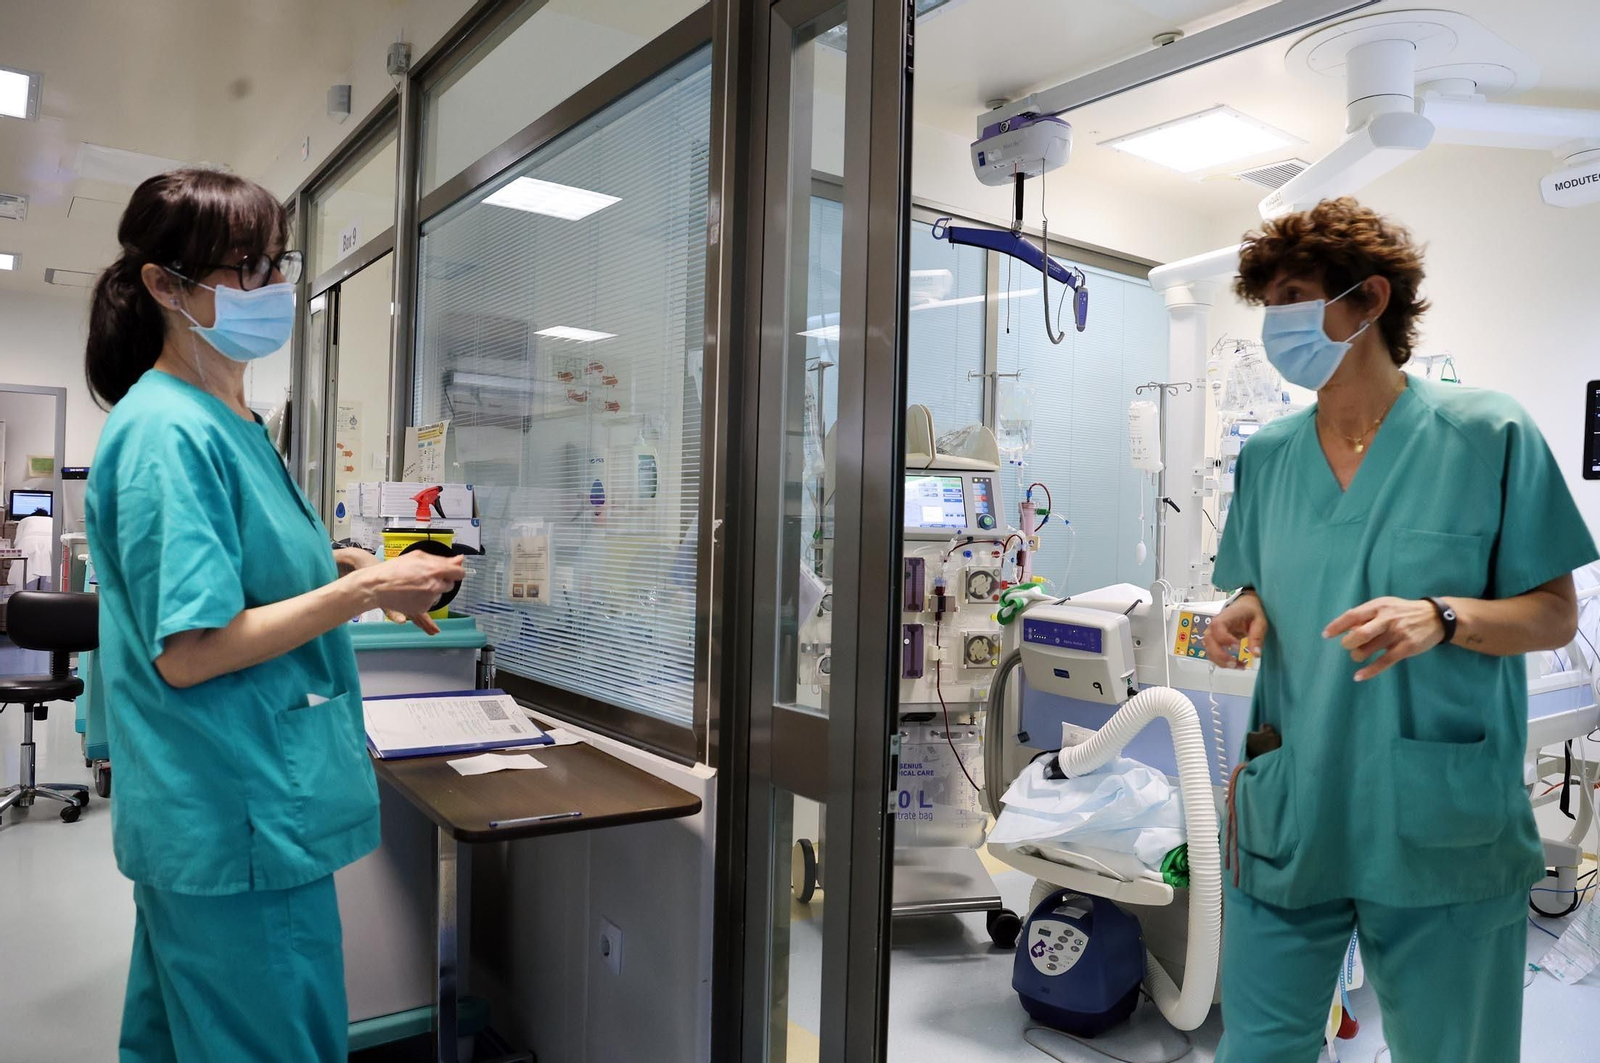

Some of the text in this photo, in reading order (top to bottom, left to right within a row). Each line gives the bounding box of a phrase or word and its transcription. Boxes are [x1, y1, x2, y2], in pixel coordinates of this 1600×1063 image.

[1555, 173, 1600, 191] MODUTE
[343, 227, 357, 252] Box 9
[1092, 682, 1103, 695] 9
[919, 790, 933, 808] L
[918, 811, 933, 821] bag
